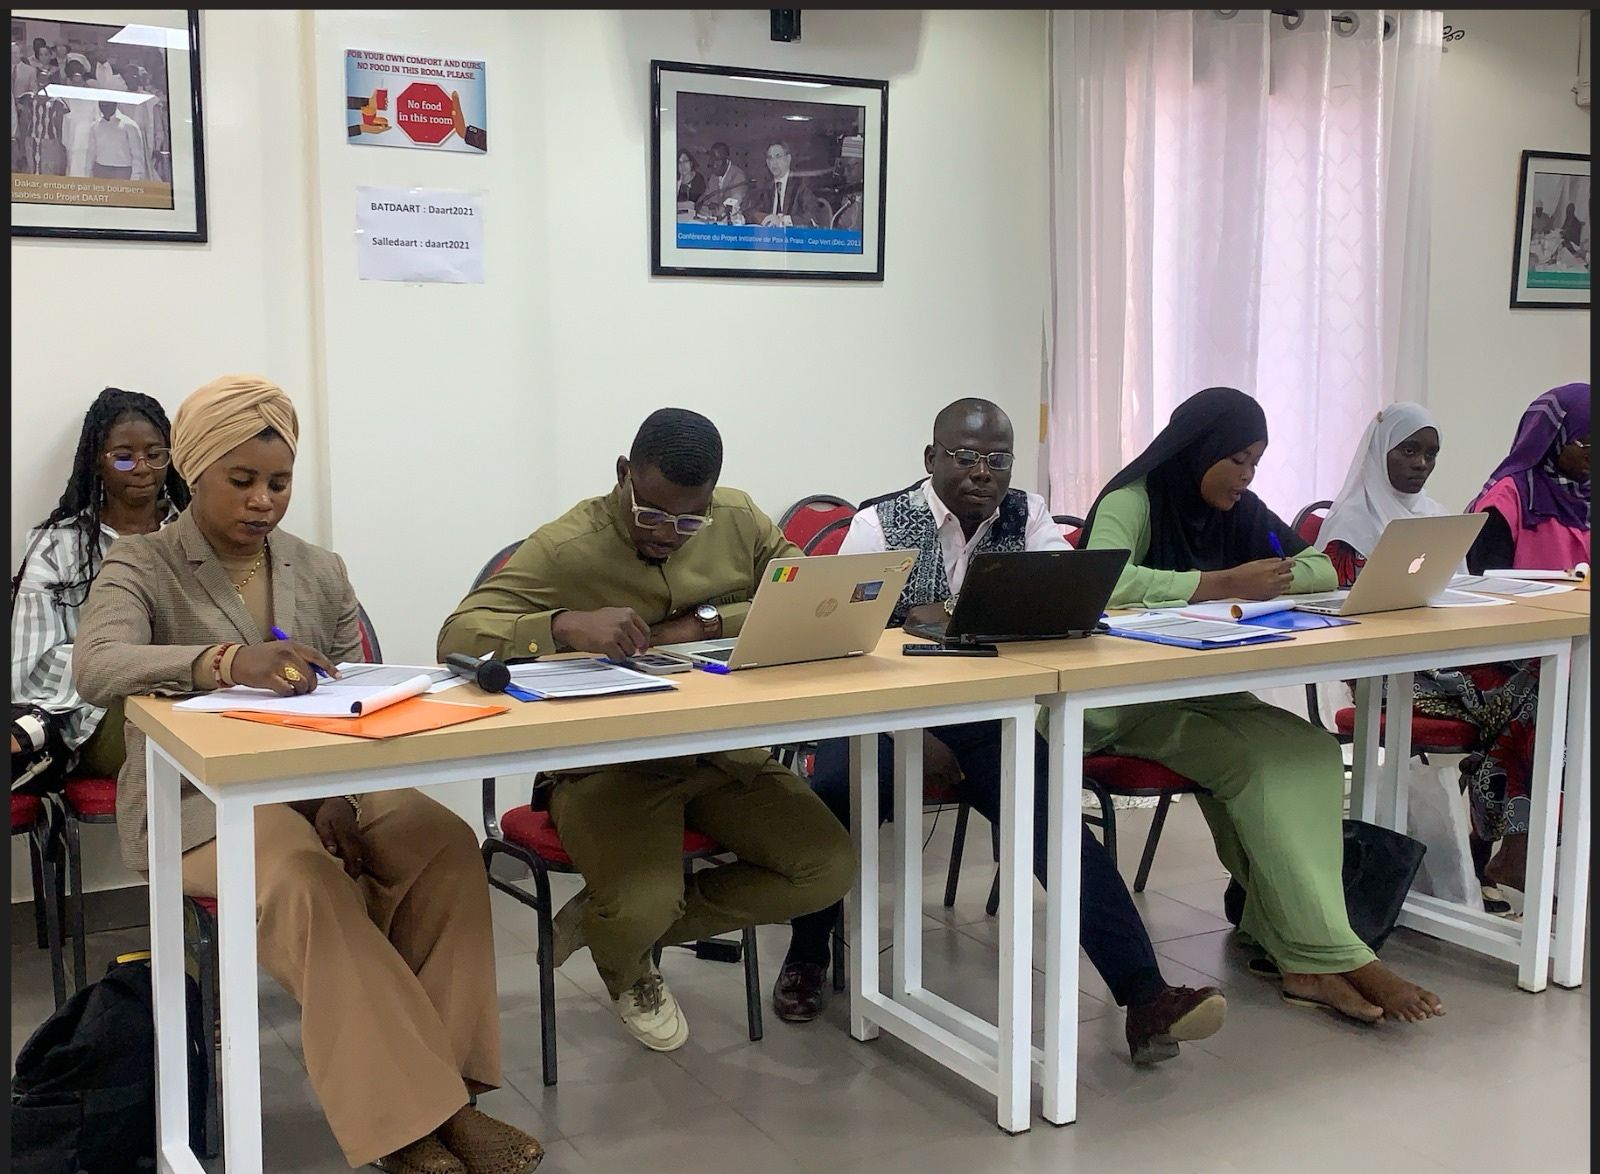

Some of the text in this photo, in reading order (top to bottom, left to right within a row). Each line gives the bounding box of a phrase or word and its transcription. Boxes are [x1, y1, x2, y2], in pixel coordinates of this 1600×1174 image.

[347, 50, 483, 71] FOR YOUR OWN COMFORT AND OURS,
[357, 62, 369, 70] NO
[370, 64, 390, 72] FOOD
[402, 67, 419, 75] THIS
[420, 69, 446, 78] ROOM,
[407, 99, 442, 111] No food
[399, 112, 453, 125] in this room
[77, 183, 91, 192] par
[93, 183, 105, 191] les
[43, 192, 54, 200] du
[56, 192, 80, 202] Projet
[82, 194, 109, 202] DAART
[371, 202, 420, 213] BATDAART
[428, 206, 474, 215] Daart2021
[372, 237, 418, 247] Salledaart
[425, 240, 470, 249] daart2021
[721, 234, 737, 243] Projet
[808, 238, 820, 246] Cap
